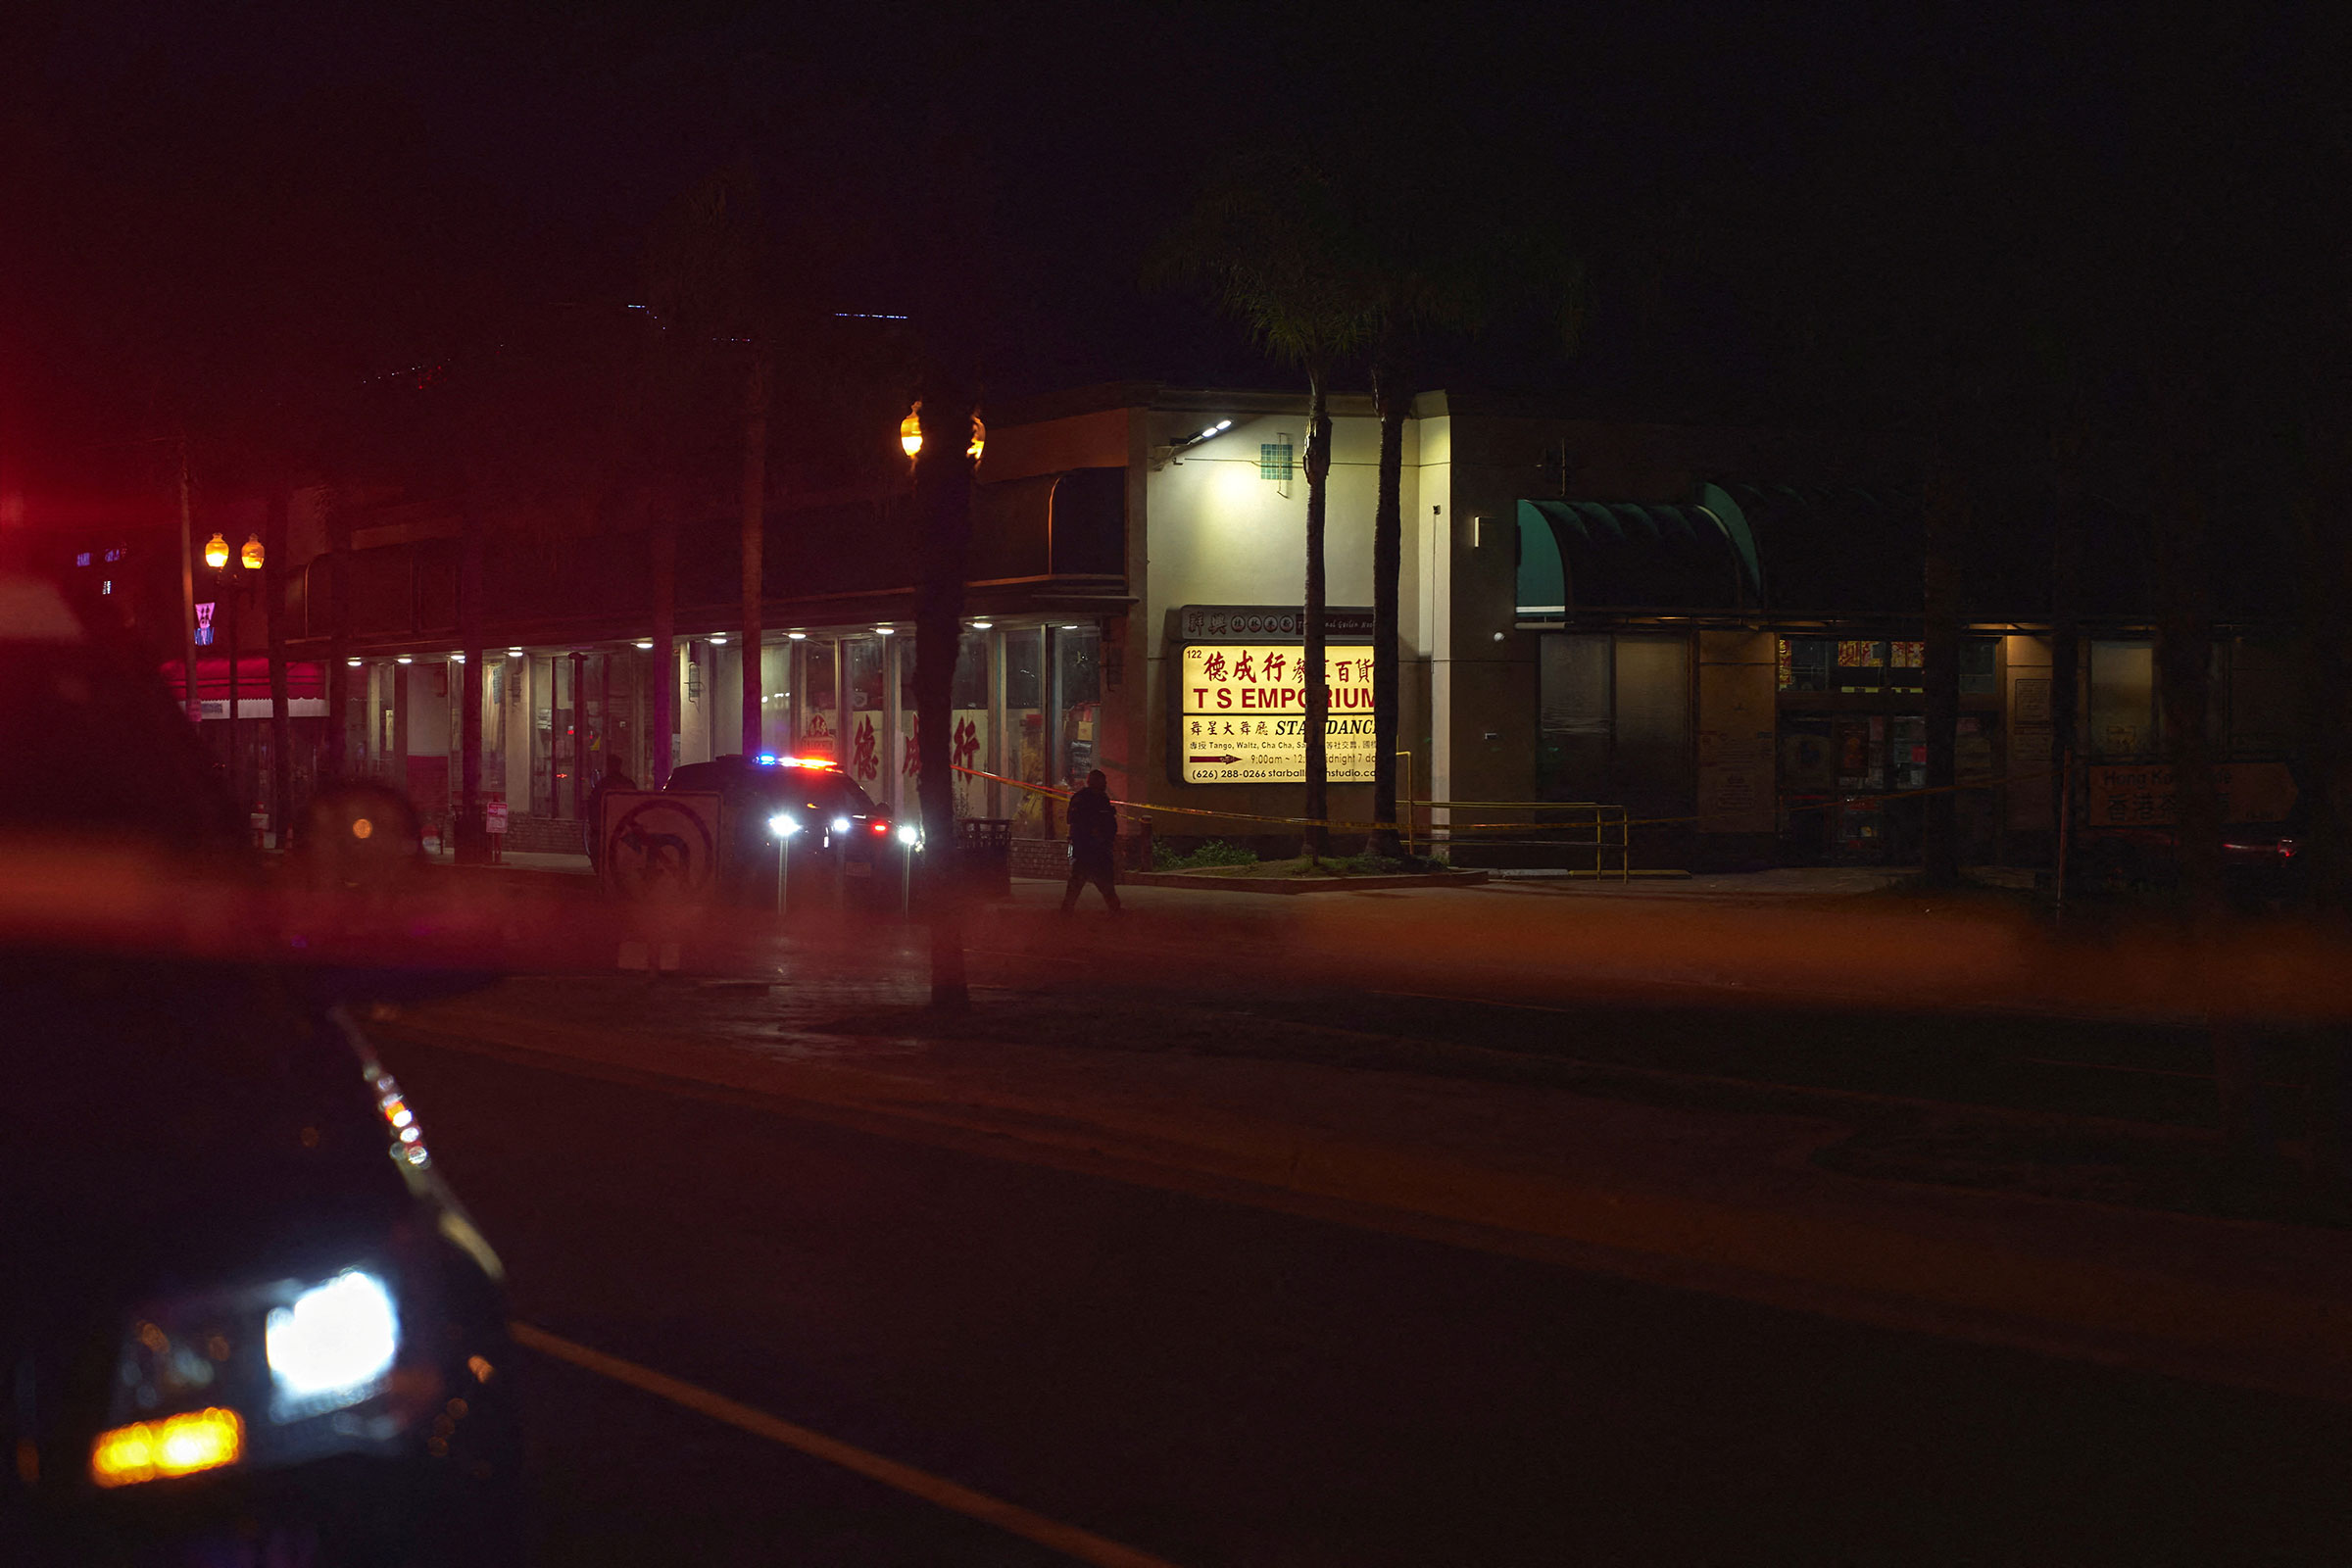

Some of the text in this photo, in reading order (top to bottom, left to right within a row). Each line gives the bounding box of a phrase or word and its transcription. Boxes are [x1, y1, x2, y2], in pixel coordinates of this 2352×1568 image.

[1187, 650, 1201, 659] 122
[1203, 649, 1375, 684] 德成行 參百貨
[1193, 688, 1208, 709] T
[1216, 687, 1232, 710] S
[1275, 720, 1306, 735] STA
[1326, 719, 1376, 735] DANC
[1209, 742, 1235, 751] Tango,
[1250, 754, 1283, 764] 9:00am
[1326, 754, 1355, 765] idnight
[1357, 754, 1362, 762] 7
[1192, 770, 1218, 780] (626)
[1221, 769, 1266, 778] 288-0266
